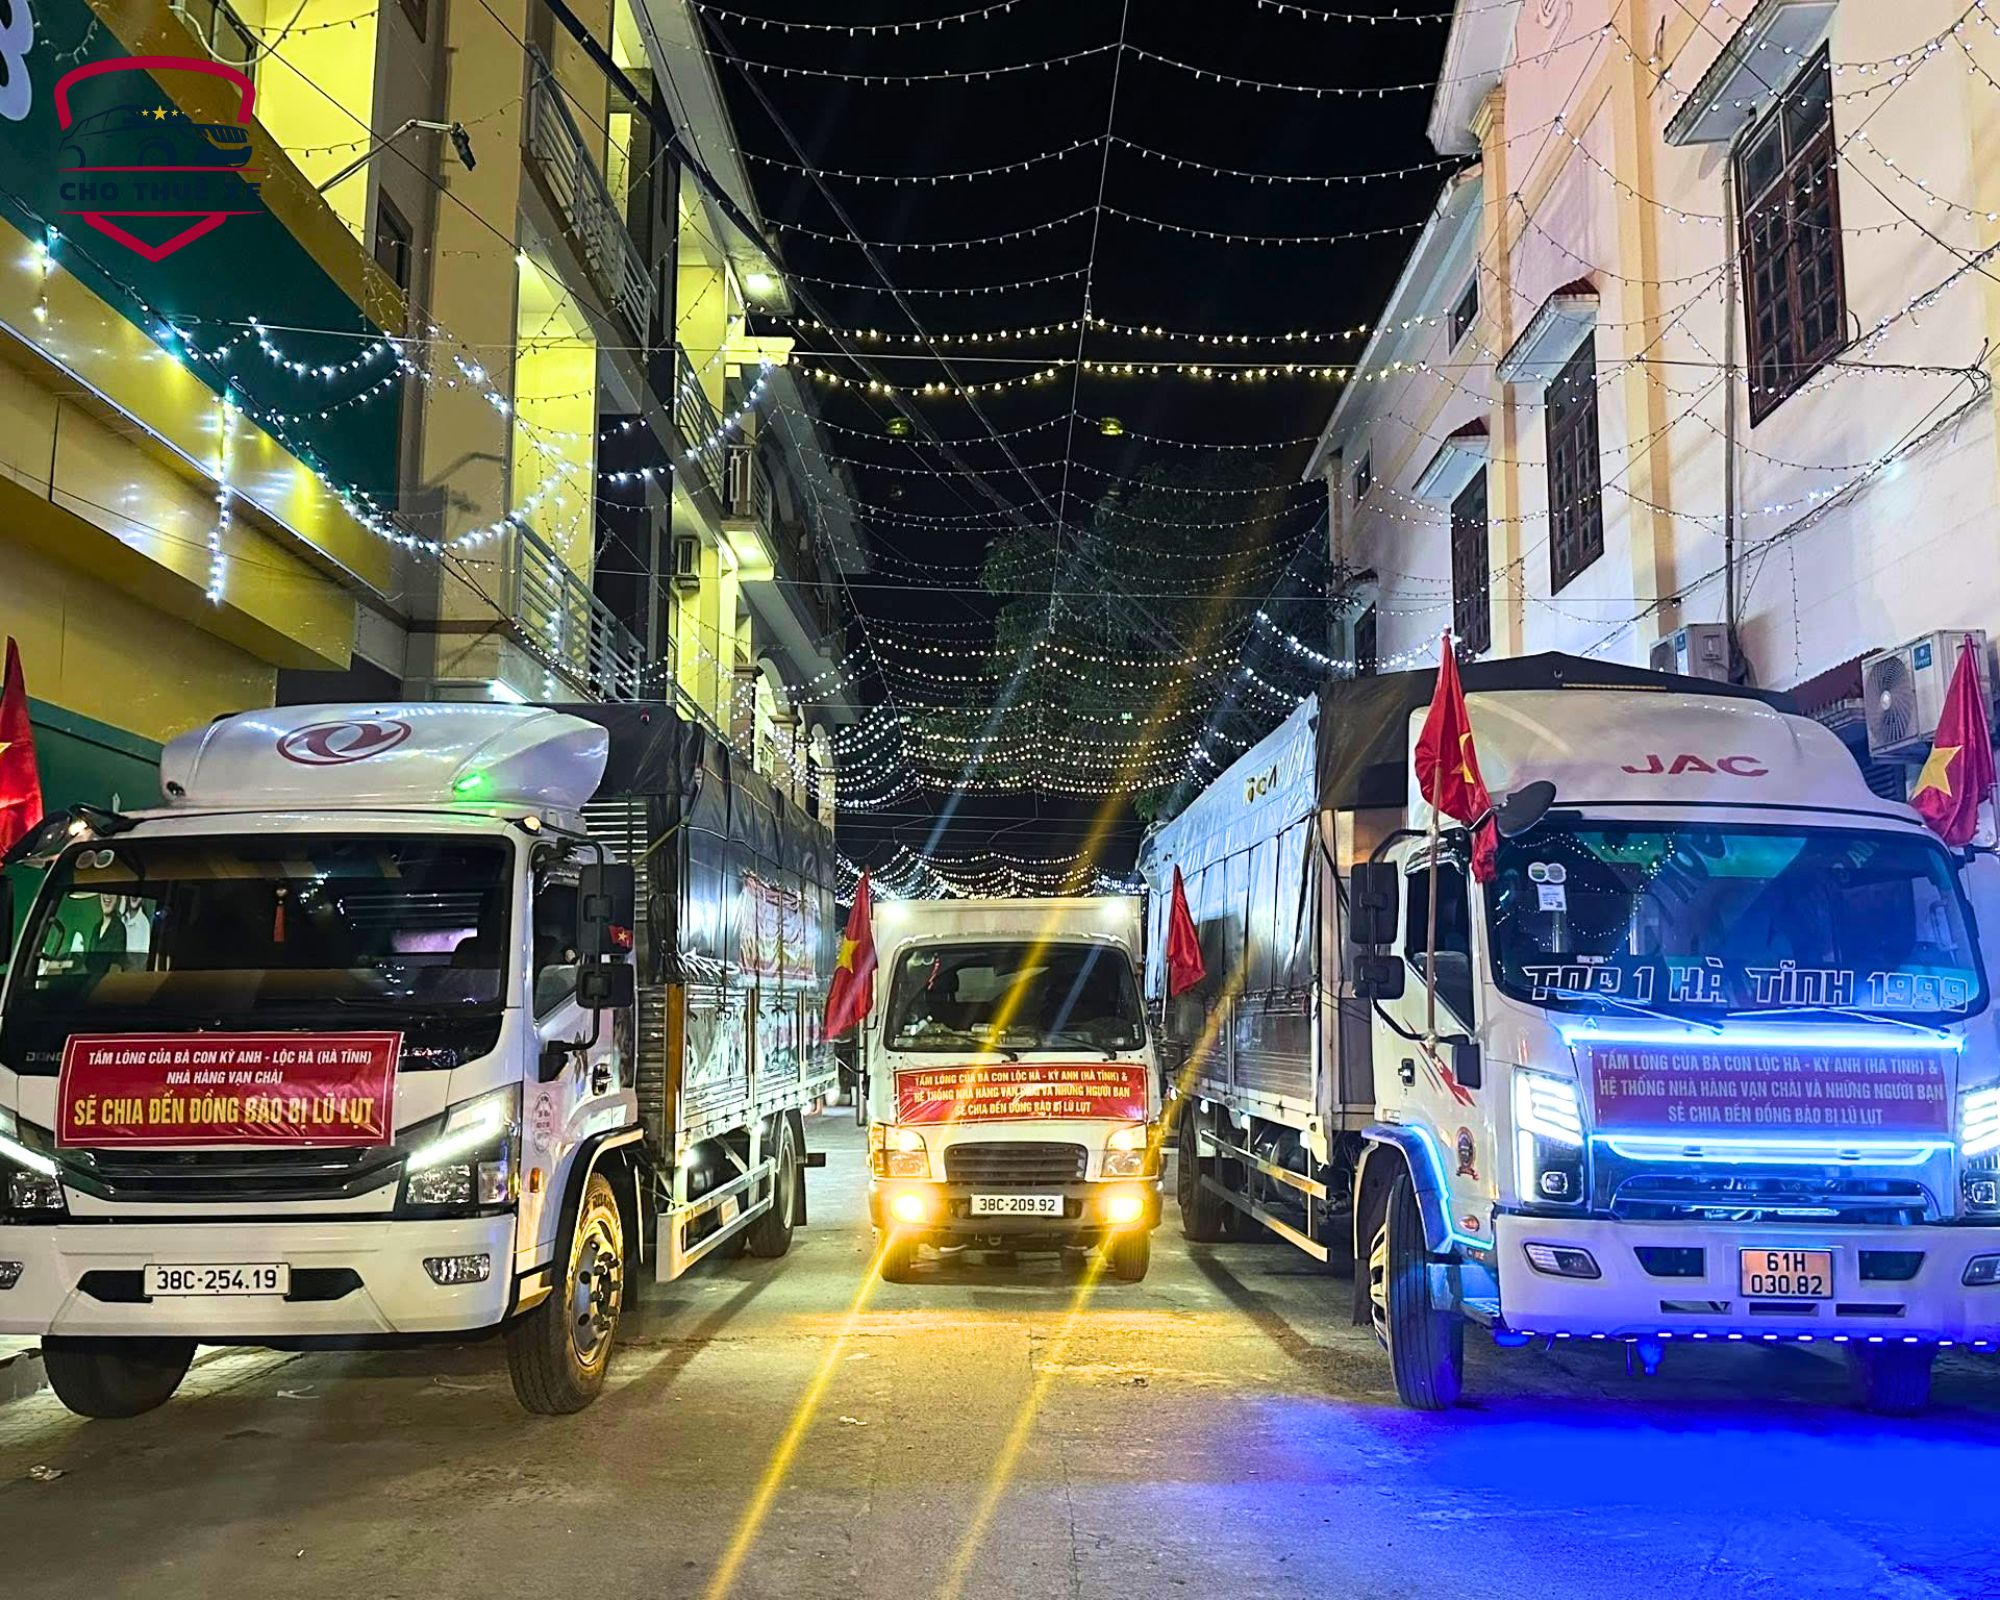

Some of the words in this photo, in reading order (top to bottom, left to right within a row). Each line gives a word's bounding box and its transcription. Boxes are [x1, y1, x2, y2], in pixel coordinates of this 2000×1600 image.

[1620, 754, 1769, 777] JAC
[1522, 965, 1622, 1001] TOP
[1633, 966, 1655, 1001] 1
[1669, 956, 1727, 1002] HÀ
[1867, 972, 1968, 1013] 1999
[89, 1048, 113, 1065] TẤM
[115, 1048, 146, 1065] LÒNG
[148, 1048, 173, 1065] CỦA
[174, 1049, 190, 1064] BÀ
[193, 1051, 217, 1064] CON
[236, 1051, 263, 1064] ANH
[272, 1048, 296, 1066] LỘC
[298, 1048, 314, 1064] HÀ
[317, 1049, 337, 1065] (HÀ
[341, 1049, 372, 1065] TĨNH)
[1600, 1049, 1629, 1070] TẤM
[1633, 1050, 1668, 1071] LÒNG
[1703, 1051, 1721, 1071] BÀ
[1724, 1055, 1751, 1071] CON
[1755, 1053, 1780, 1075] LỘC
[1834, 1057, 1861, 1073] ANH
[1928, 1060, 1938, 1075] &
[166, 1071, 190, 1085] NHÀ
[193, 1070, 226, 1084] HÀNG
[228, 1071, 252, 1086] VẠN
[254, 1070, 283, 1084] CHÀI
[991, 1072, 1008, 1083] CON
[1028, 1069, 1041, 1081] HÀ
[1061, 1070, 1079, 1081] ANH
[1121, 1072, 1128, 1081] &
[1600, 1076, 1617, 1099] HỆ
[1669, 1076, 1697, 1097] NHÀ
[1700, 1077, 1736, 1097] HÀNG
[1740, 1080, 1767, 1100] VẠN
[1771, 1078, 1801, 1098] CHÀI
[1805, 1078, 1822, 1098] VÀ
[1917, 1083, 1944, 1103] BẠN
[101, 1098, 144, 1126] CHIA
[148, 1089, 185, 1125] ĐẾN
[189, 1088, 239, 1125] ĐỒNG
[287, 1098, 308, 1129] BỊ
[312, 1092, 336, 1125] LŨ
[340, 1098, 375, 1129] LỤT
[968, 1104, 988, 1116] CHIA
[1076, 1101, 1092, 1114] LỤT
[1689, 1105, 1721, 1123] CHIA
[1724, 1102, 1751, 1123] ĐẾN
[1825, 1107, 1838, 1127] BỊ
[1861, 1108, 1883, 1127] LỤT
[979, 1198, 1056, 1212] 38C-209.92
[1766, 1252, 1806, 1273] 61H
[156, 1269, 277, 1290] 38C-254.19
[1751, 1274, 1823, 1295] 030.82
